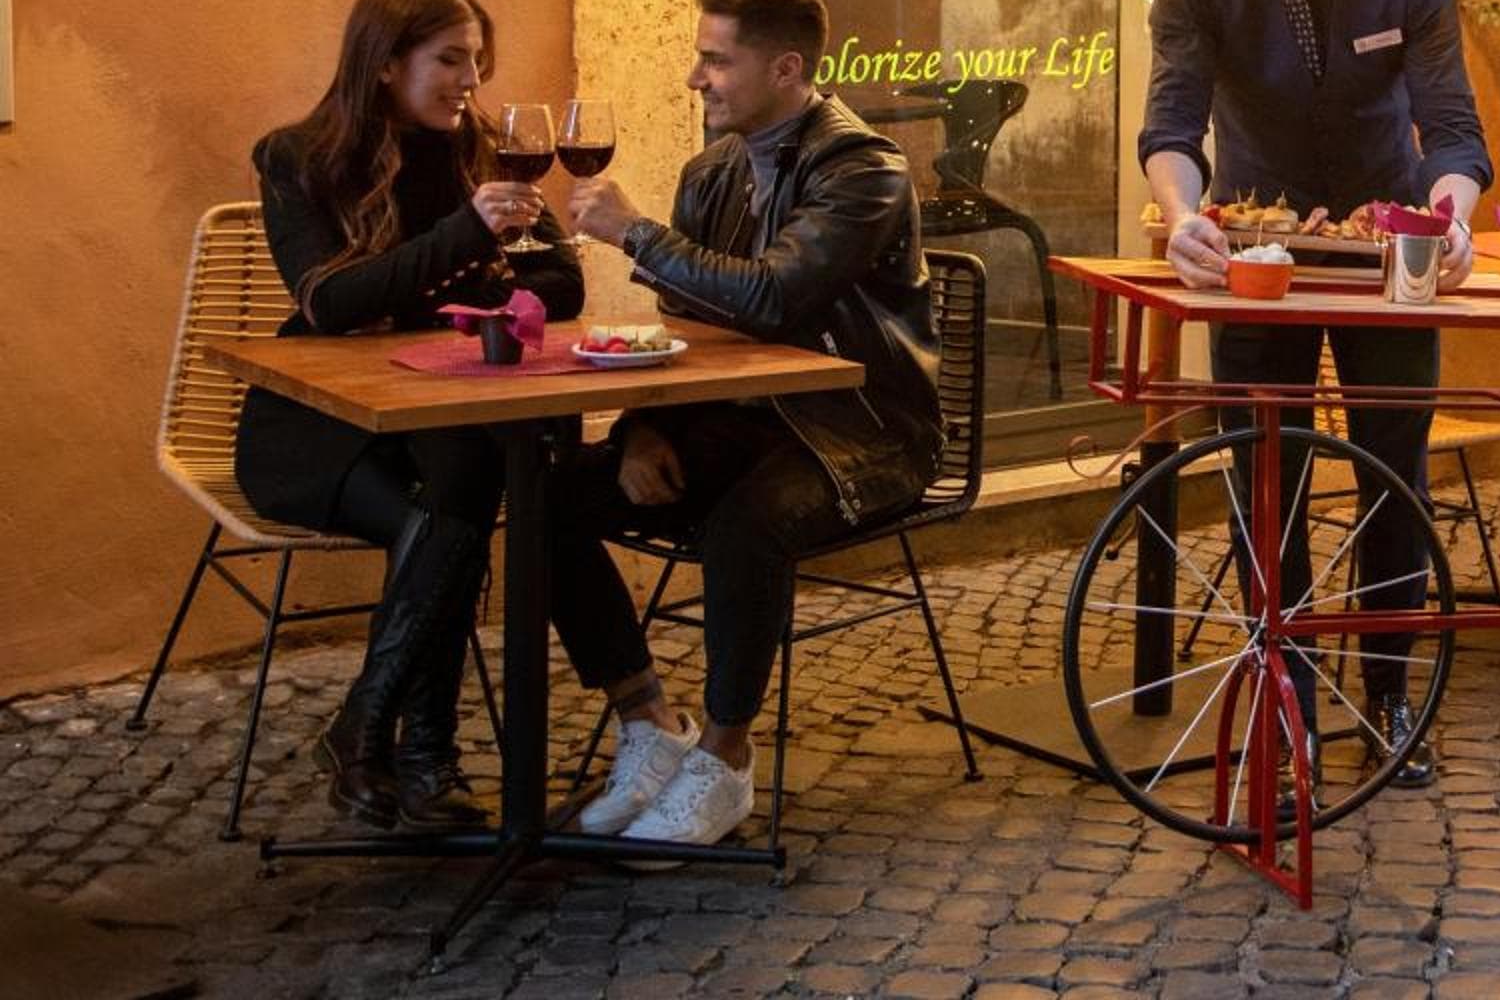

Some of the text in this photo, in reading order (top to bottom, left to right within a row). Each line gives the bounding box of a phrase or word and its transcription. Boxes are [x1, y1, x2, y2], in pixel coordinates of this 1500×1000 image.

[814, 31, 1116, 93] olorize your Life
